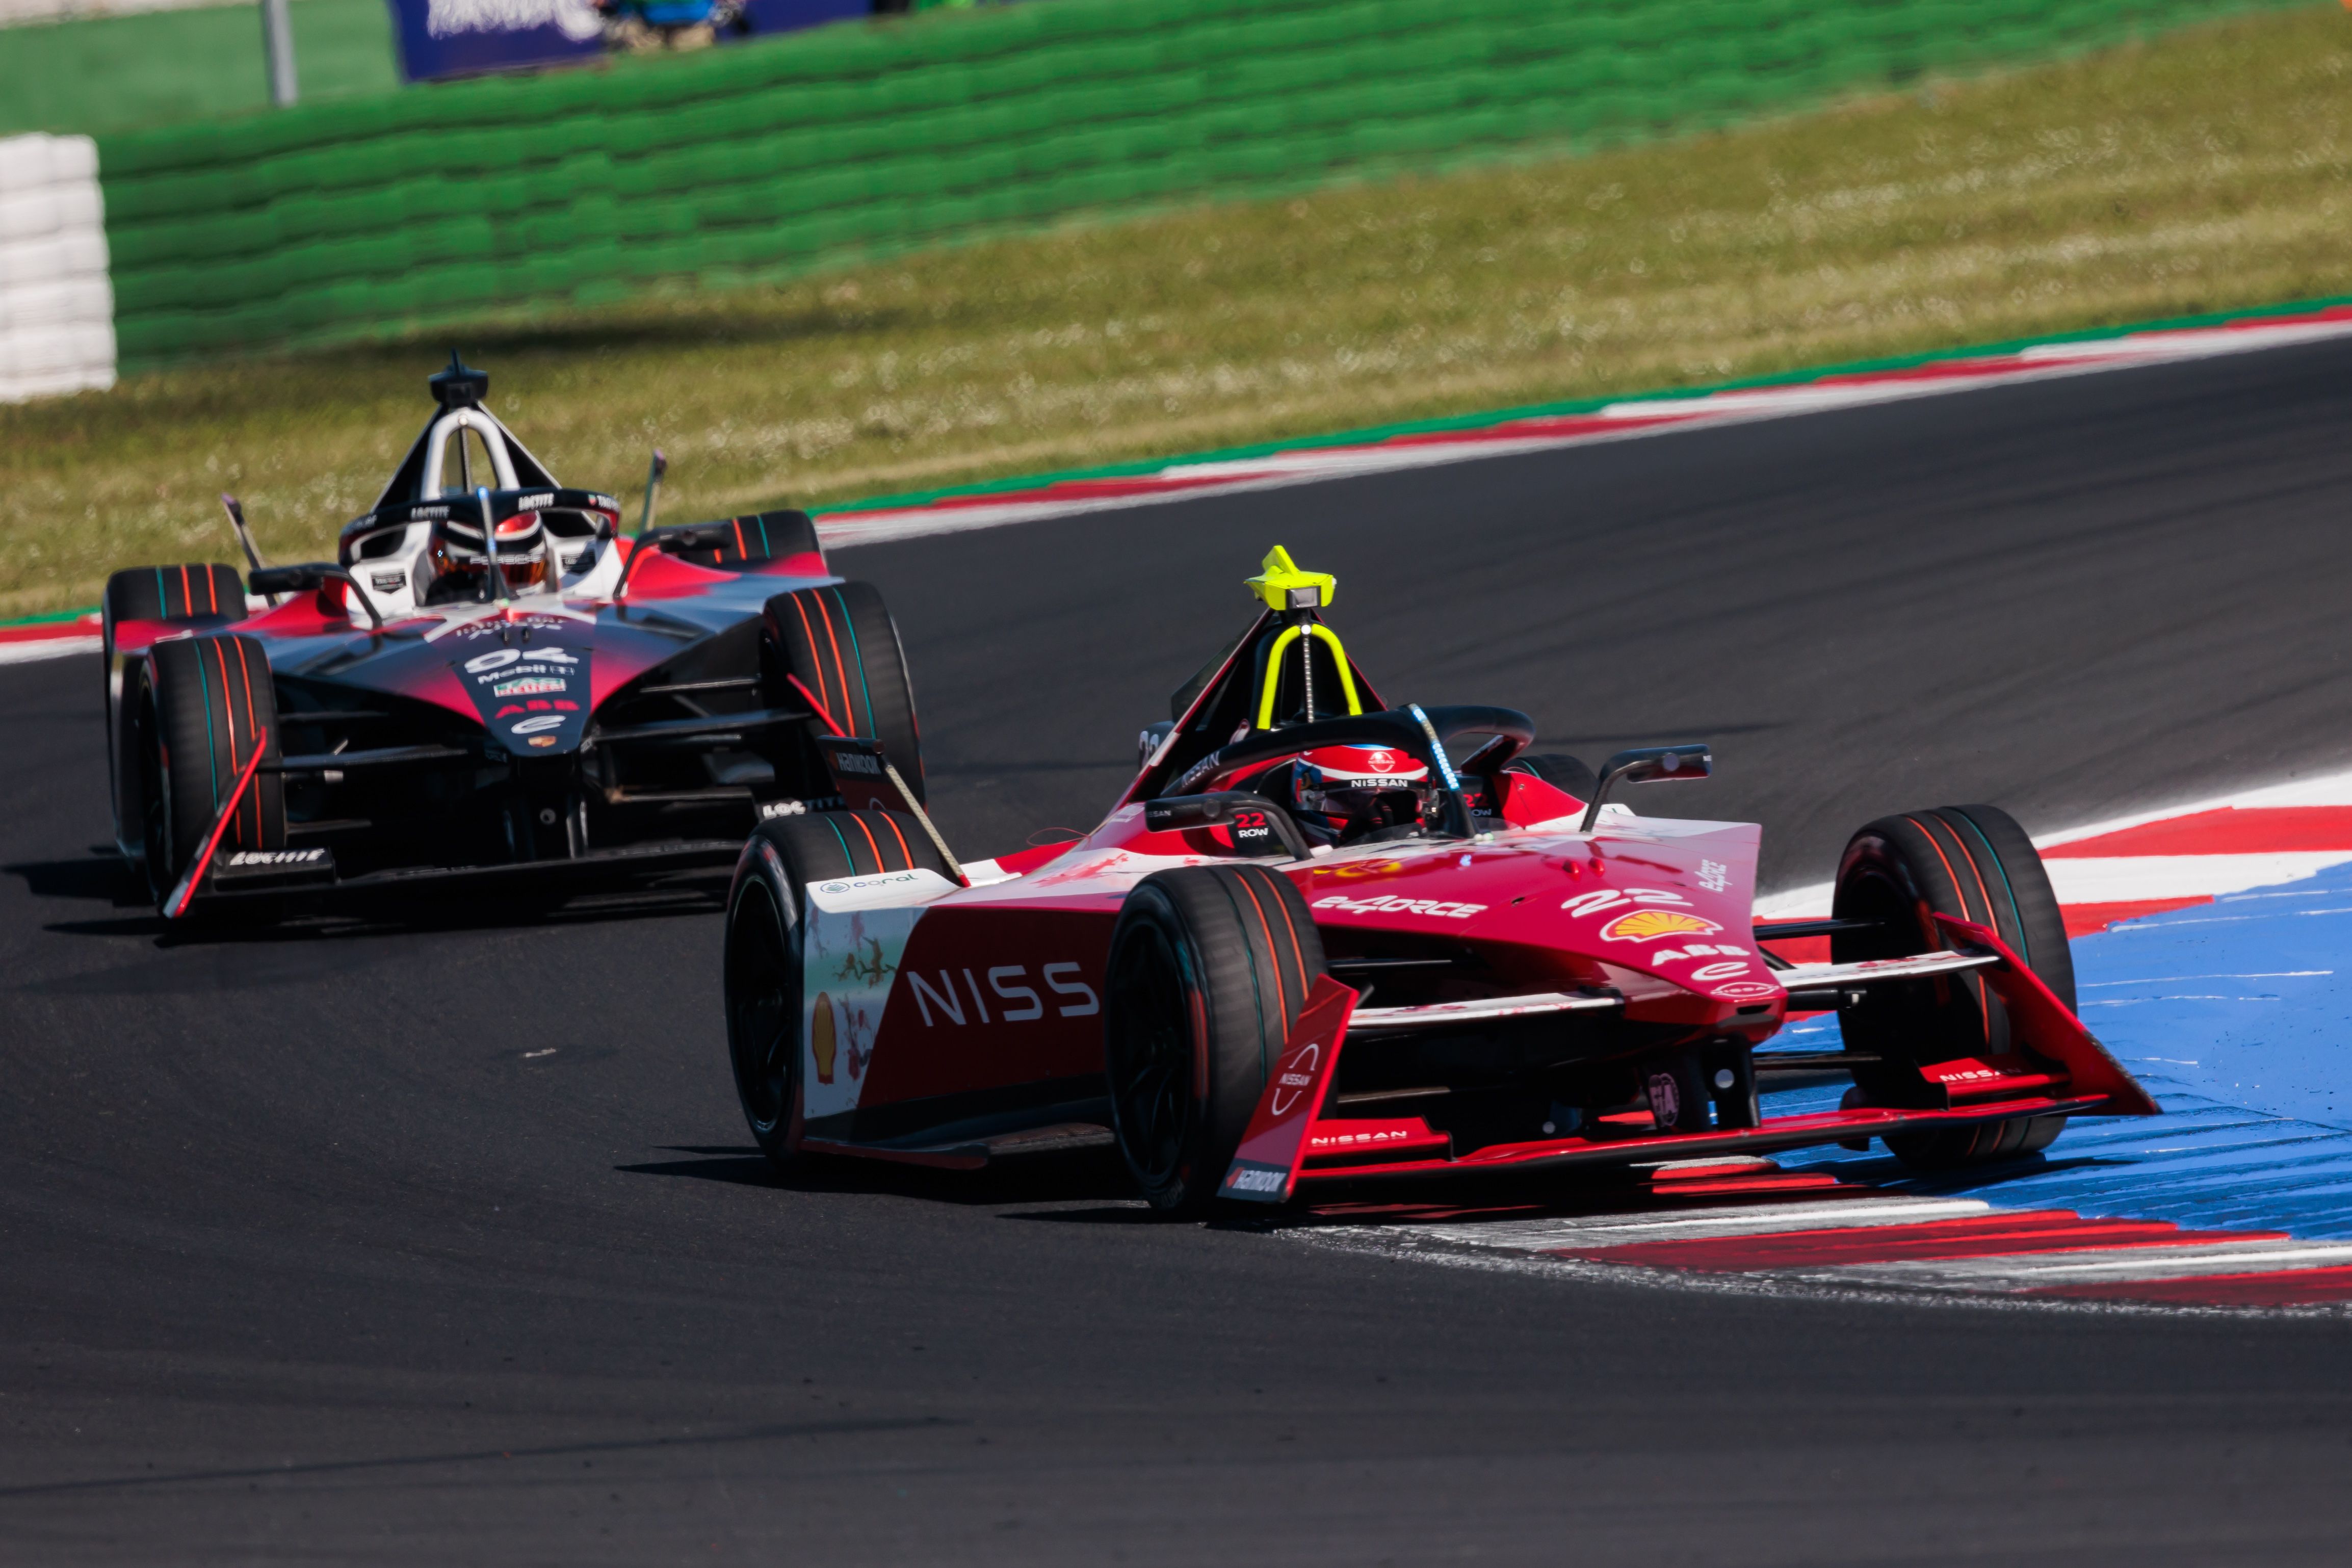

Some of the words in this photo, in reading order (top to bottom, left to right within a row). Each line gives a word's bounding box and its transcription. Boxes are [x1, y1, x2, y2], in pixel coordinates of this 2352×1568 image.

[518, 493, 554, 510] LOCTITE
[478, 664, 546, 685] Mobil
[494, 699, 580, 719] ABB
[1351, 779, 1408, 788] NISSAN
[1236, 813, 1267, 827] 22
[1238, 828, 1269, 838] ROW
[230, 848, 325, 866] LOCTITE
[1561, 888, 1695, 918] 22
[1652, 945, 1751, 966] ABB
[1278, 1073, 1312, 1086] NISSAN
[1312, 1130, 1407, 1145] NISSAN
